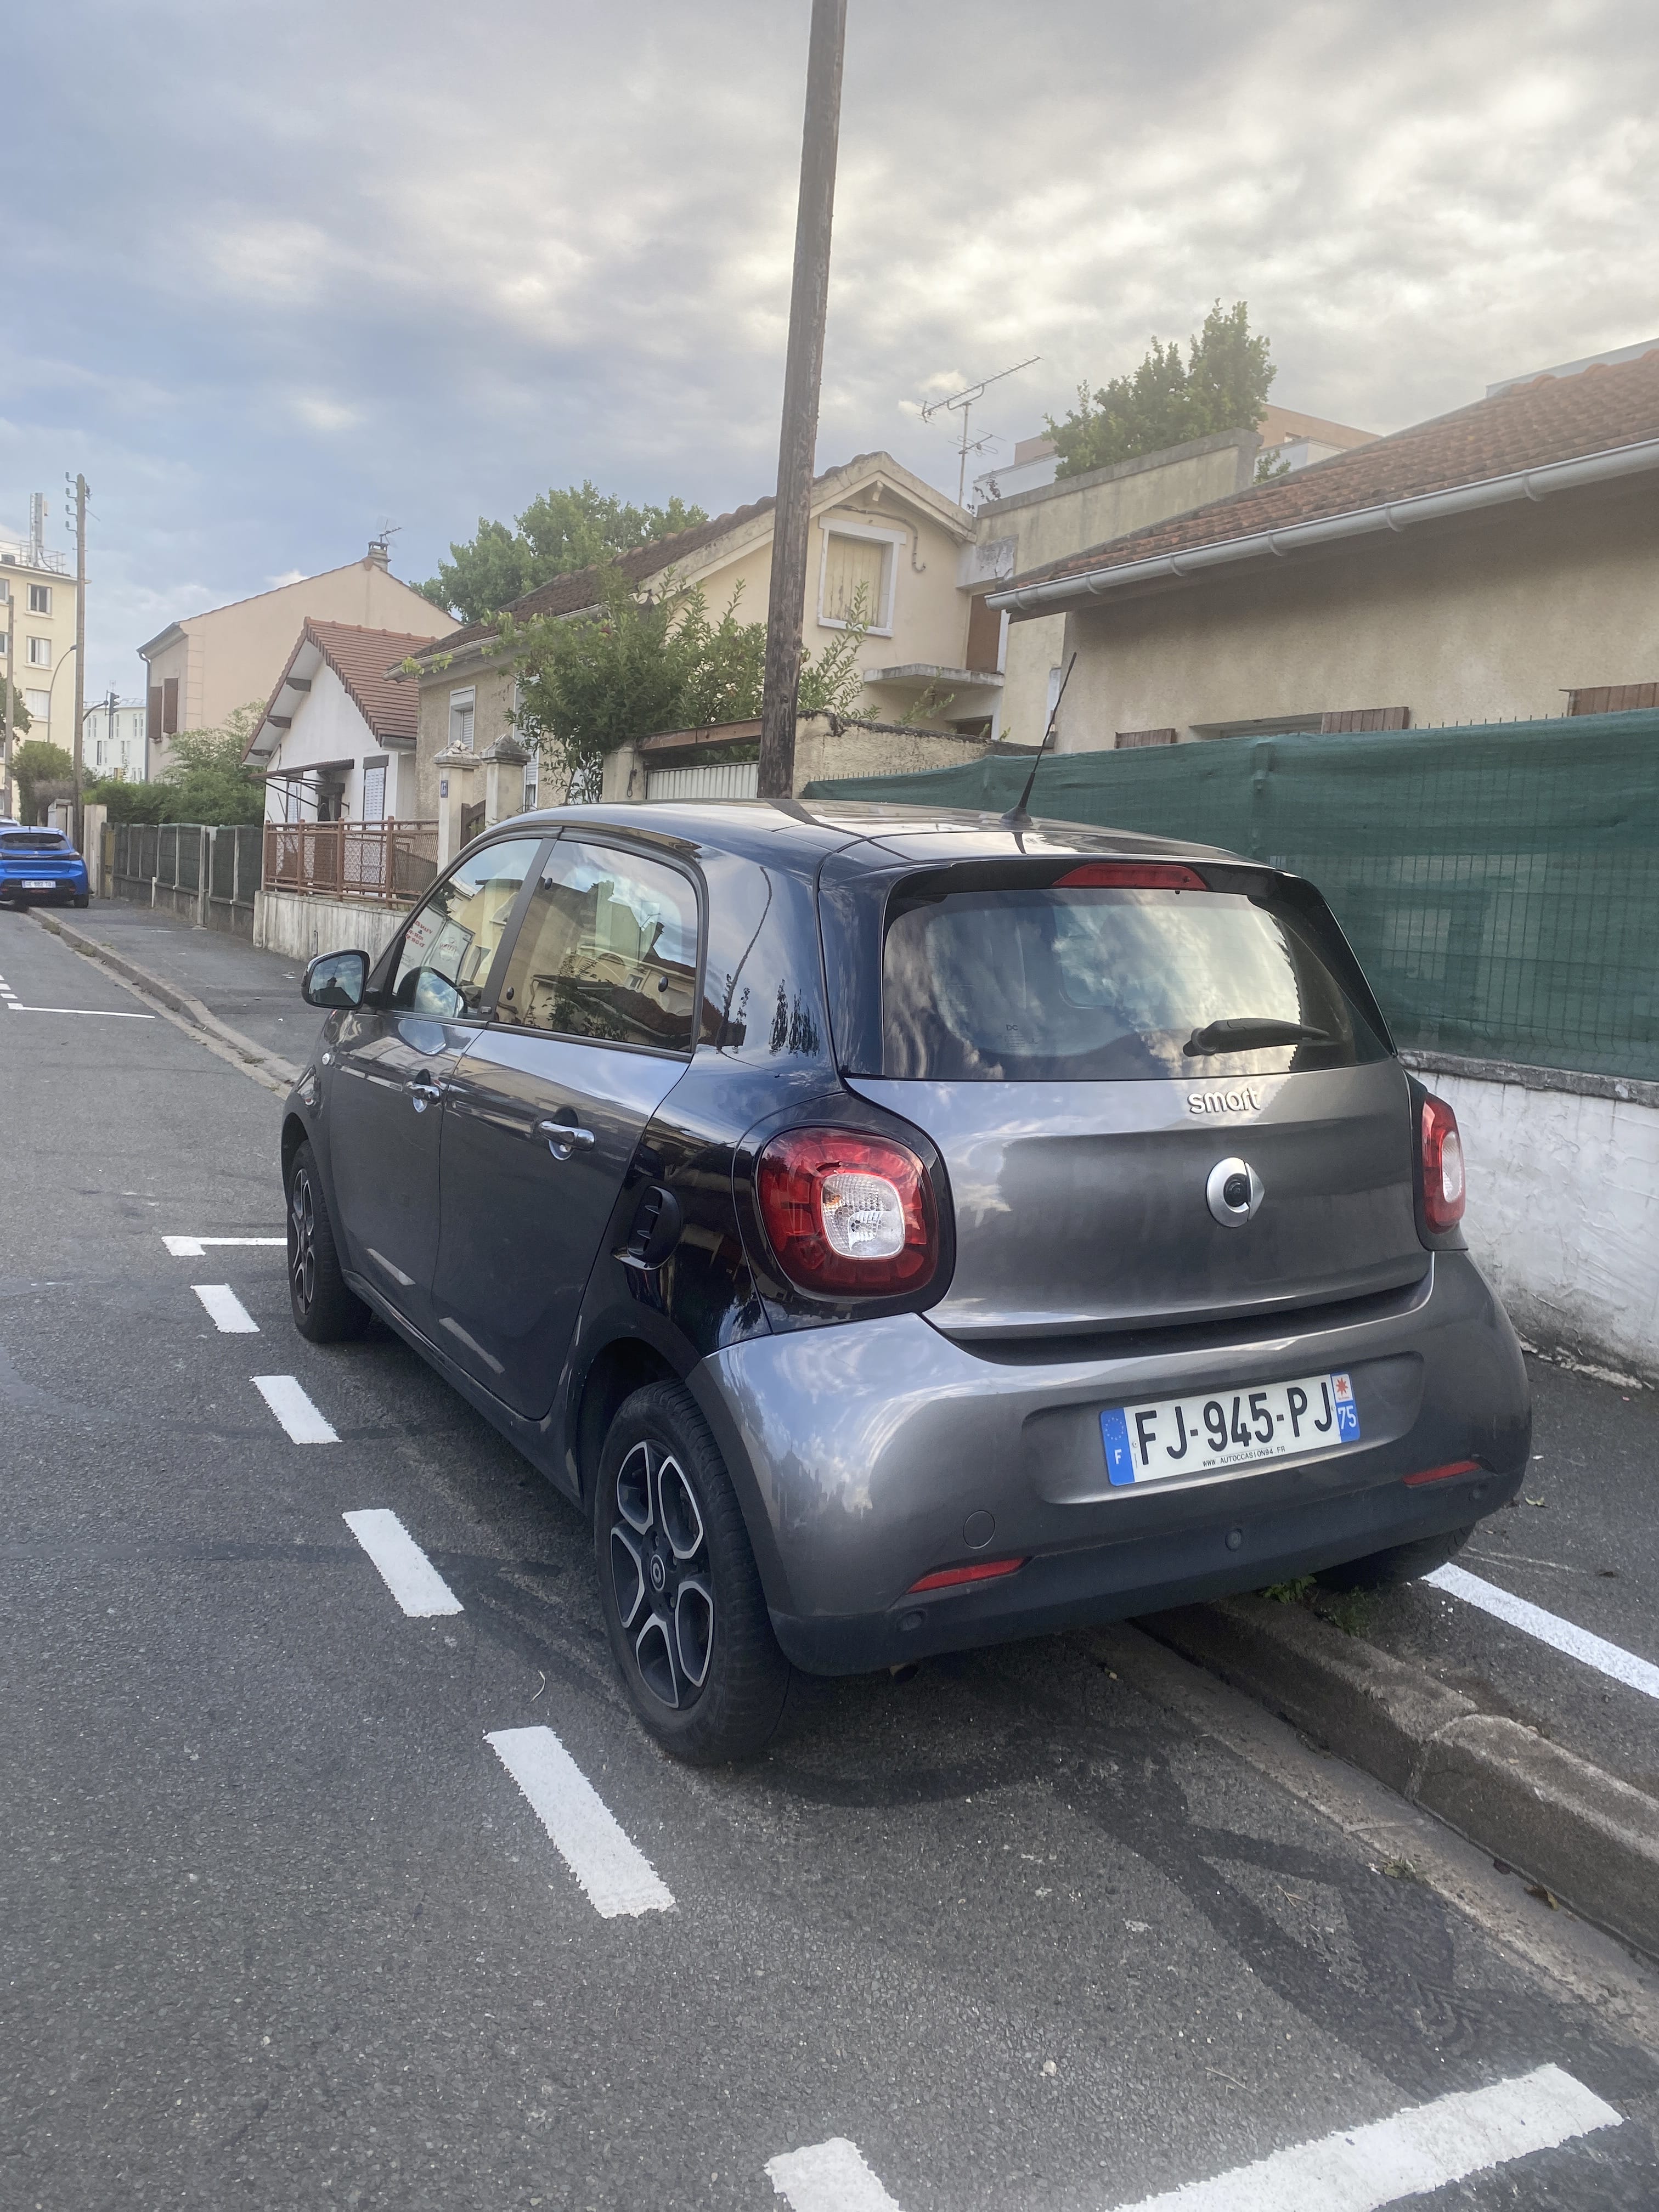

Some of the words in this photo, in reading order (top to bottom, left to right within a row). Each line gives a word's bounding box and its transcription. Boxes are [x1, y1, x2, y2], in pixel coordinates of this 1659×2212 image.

[1187, 1087, 1261, 1114] smart
[1135, 1382, 1332, 1465] FJ-945-PJ
[1338, 1405, 1357, 1430] 75
[1114, 1449, 1122, 1464] F
